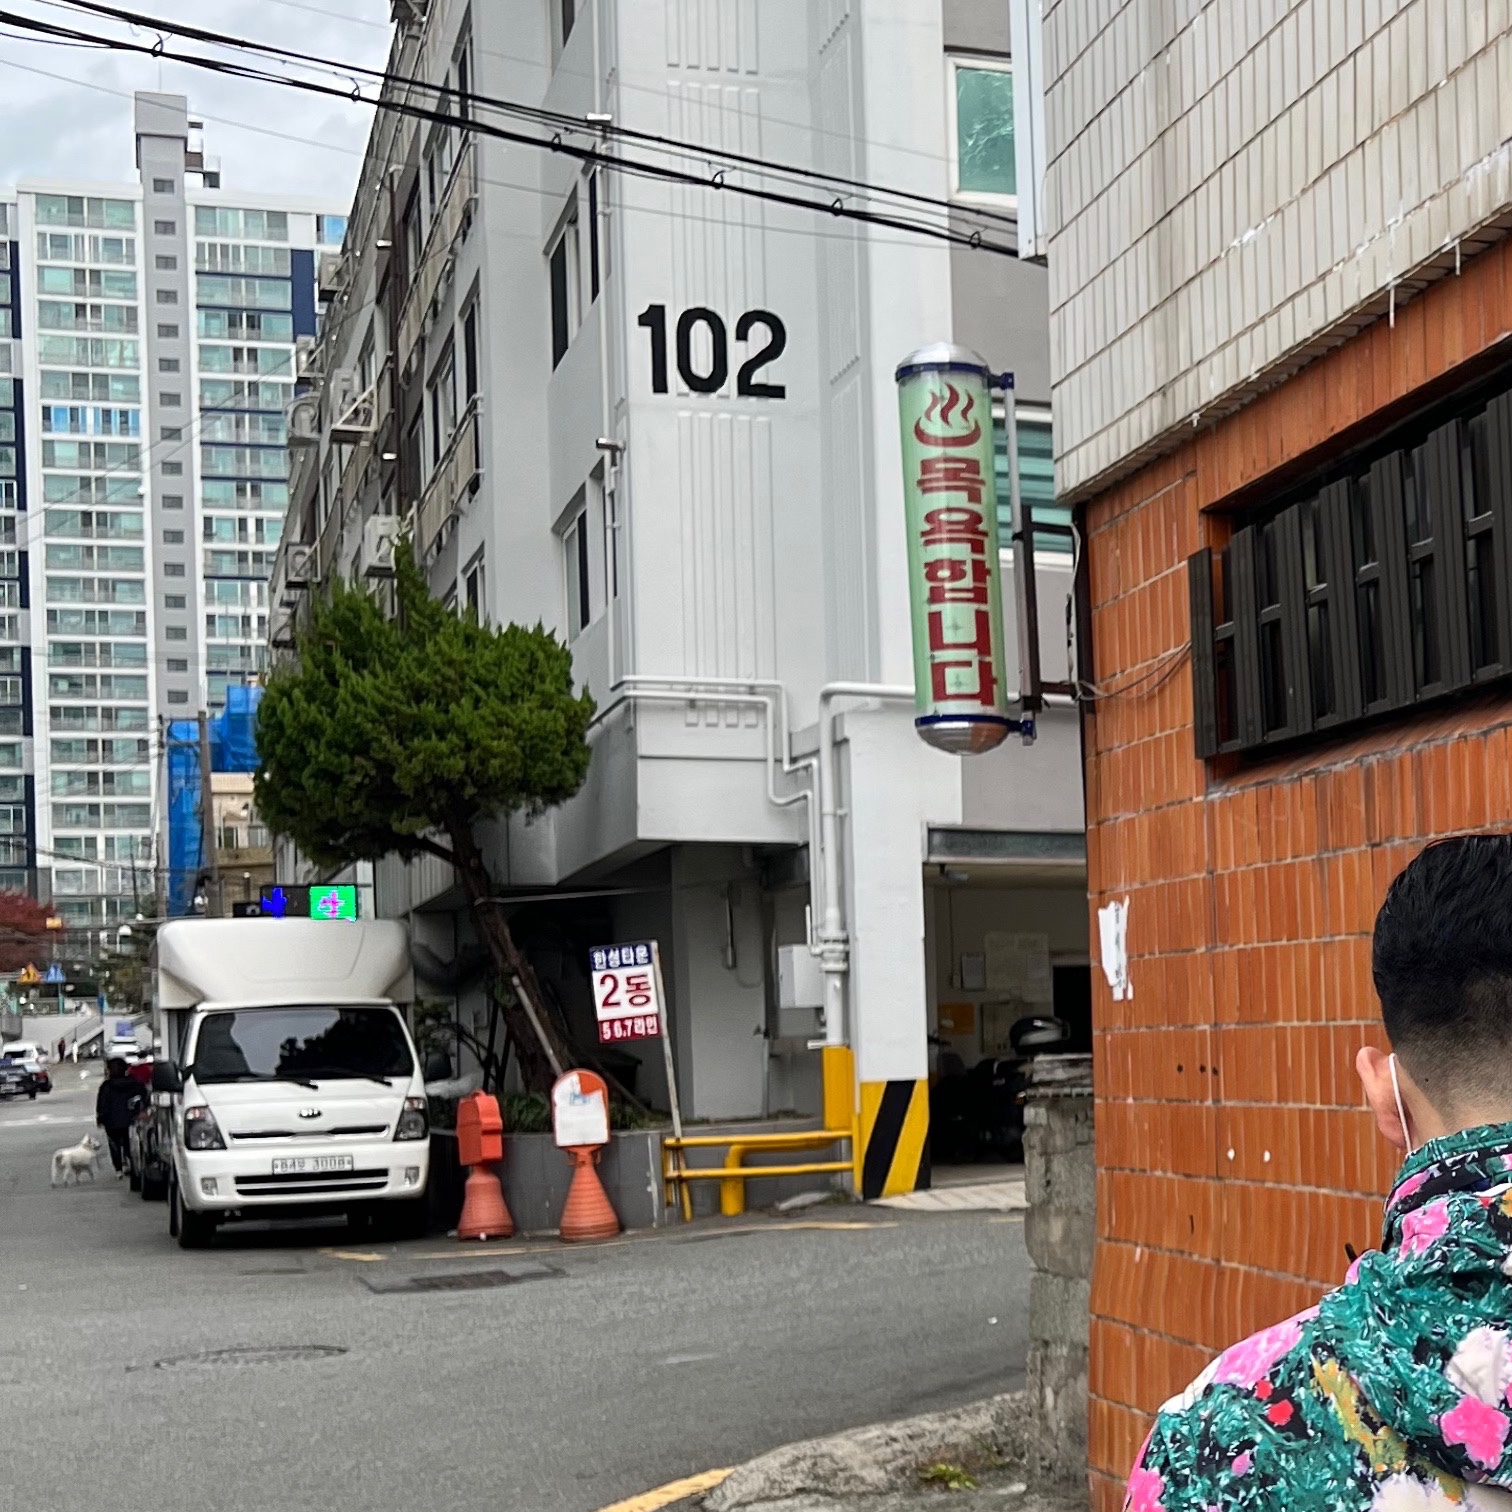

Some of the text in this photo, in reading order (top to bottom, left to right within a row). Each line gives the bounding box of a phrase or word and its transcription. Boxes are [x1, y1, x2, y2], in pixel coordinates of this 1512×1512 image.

[638, 304, 786, 399] 102
[916, 457, 998, 706] 목욕합니다
[600, 973, 652, 1007] 2동
